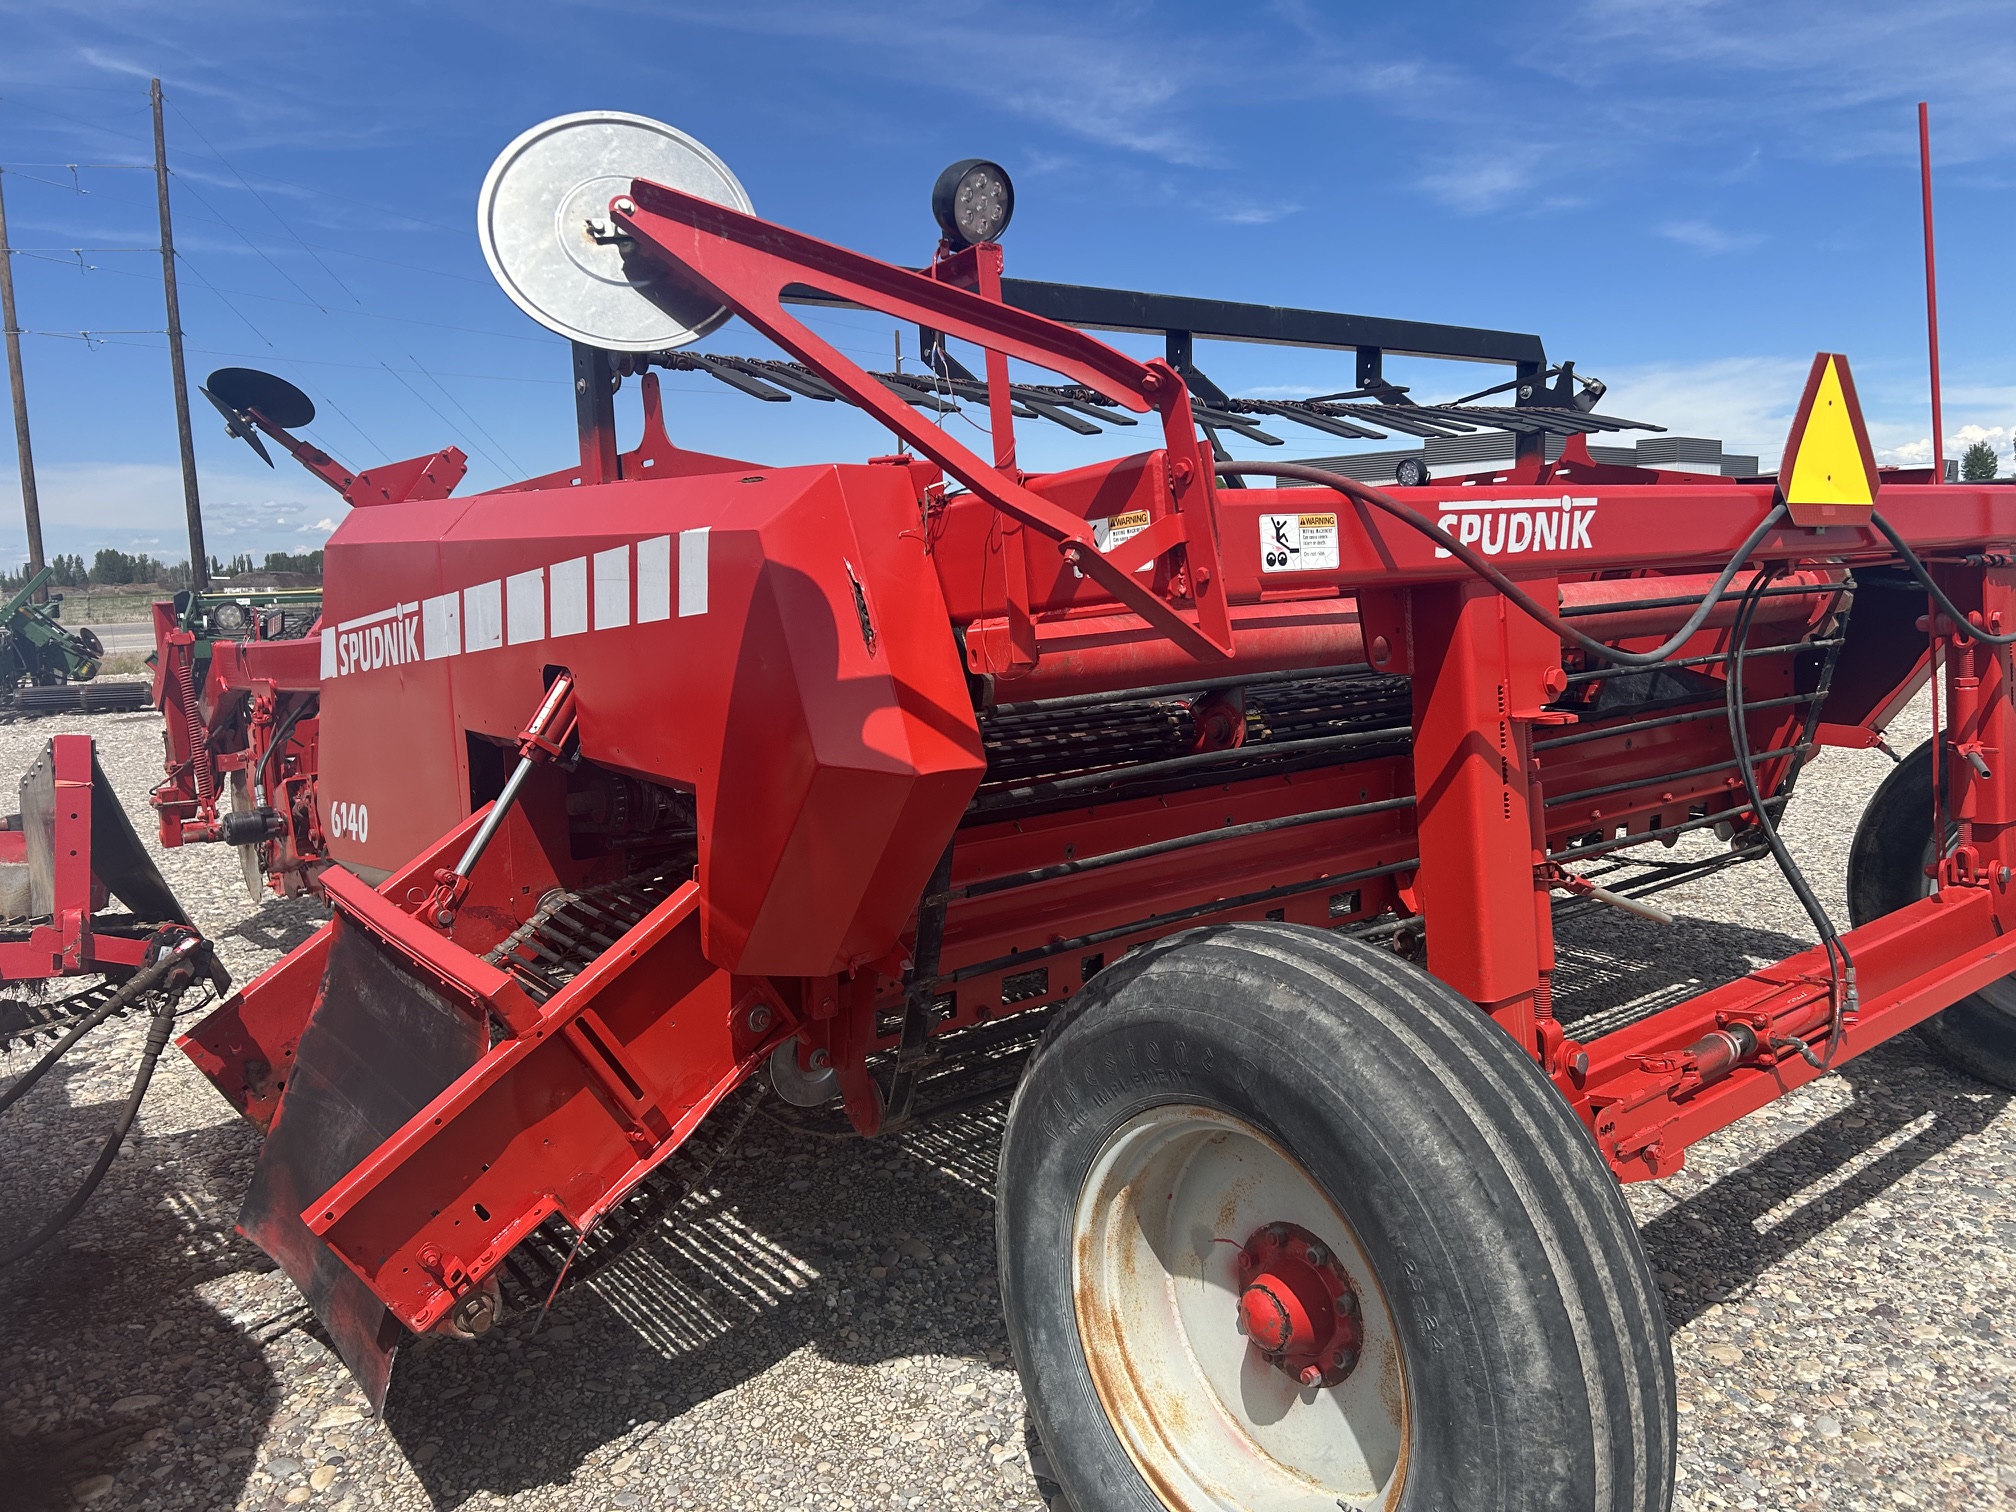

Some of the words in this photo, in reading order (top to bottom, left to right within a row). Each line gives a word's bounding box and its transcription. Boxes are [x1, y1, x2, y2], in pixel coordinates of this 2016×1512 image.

[1115, 514, 1147, 527] WARNING
[1305, 516, 1335, 525] WARNING
[1435, 495, 1596, 559] SPUDNIK
[338, 602, 420, 676] SPUDNIK
[330, 800, 368, 843] 6140
[1092, 1068, 1193, 1108] IMPLEMENT
